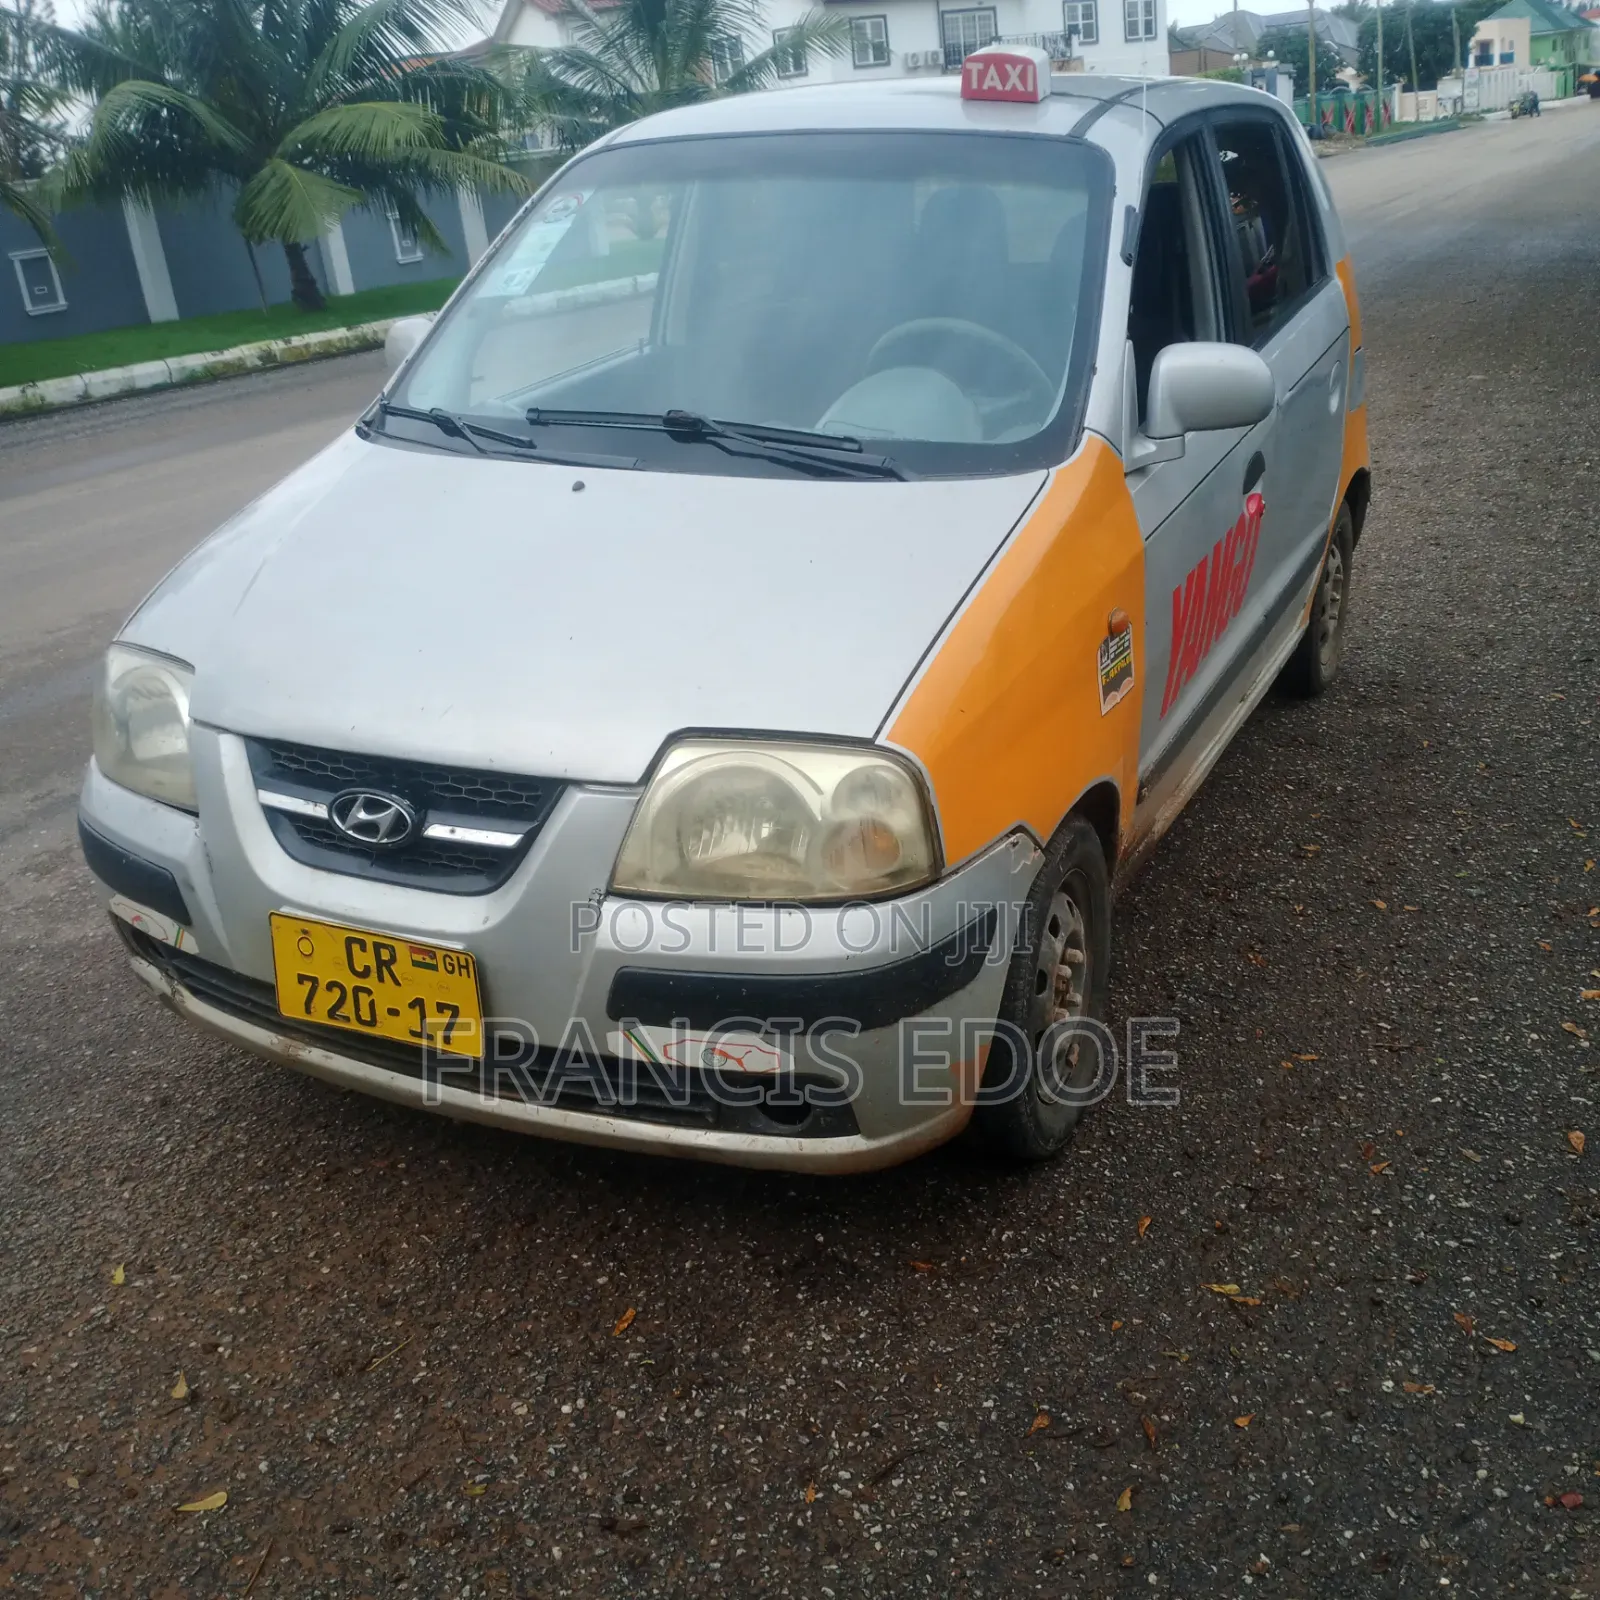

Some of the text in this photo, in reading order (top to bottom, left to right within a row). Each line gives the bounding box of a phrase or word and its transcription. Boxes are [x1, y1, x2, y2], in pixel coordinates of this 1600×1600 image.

[965, 62, 1034, 92] TAXI
[345, 936, 401, 987] CR
[443, 954, 471, 978] GH
[297, 973, 460, 1045] 720-17
